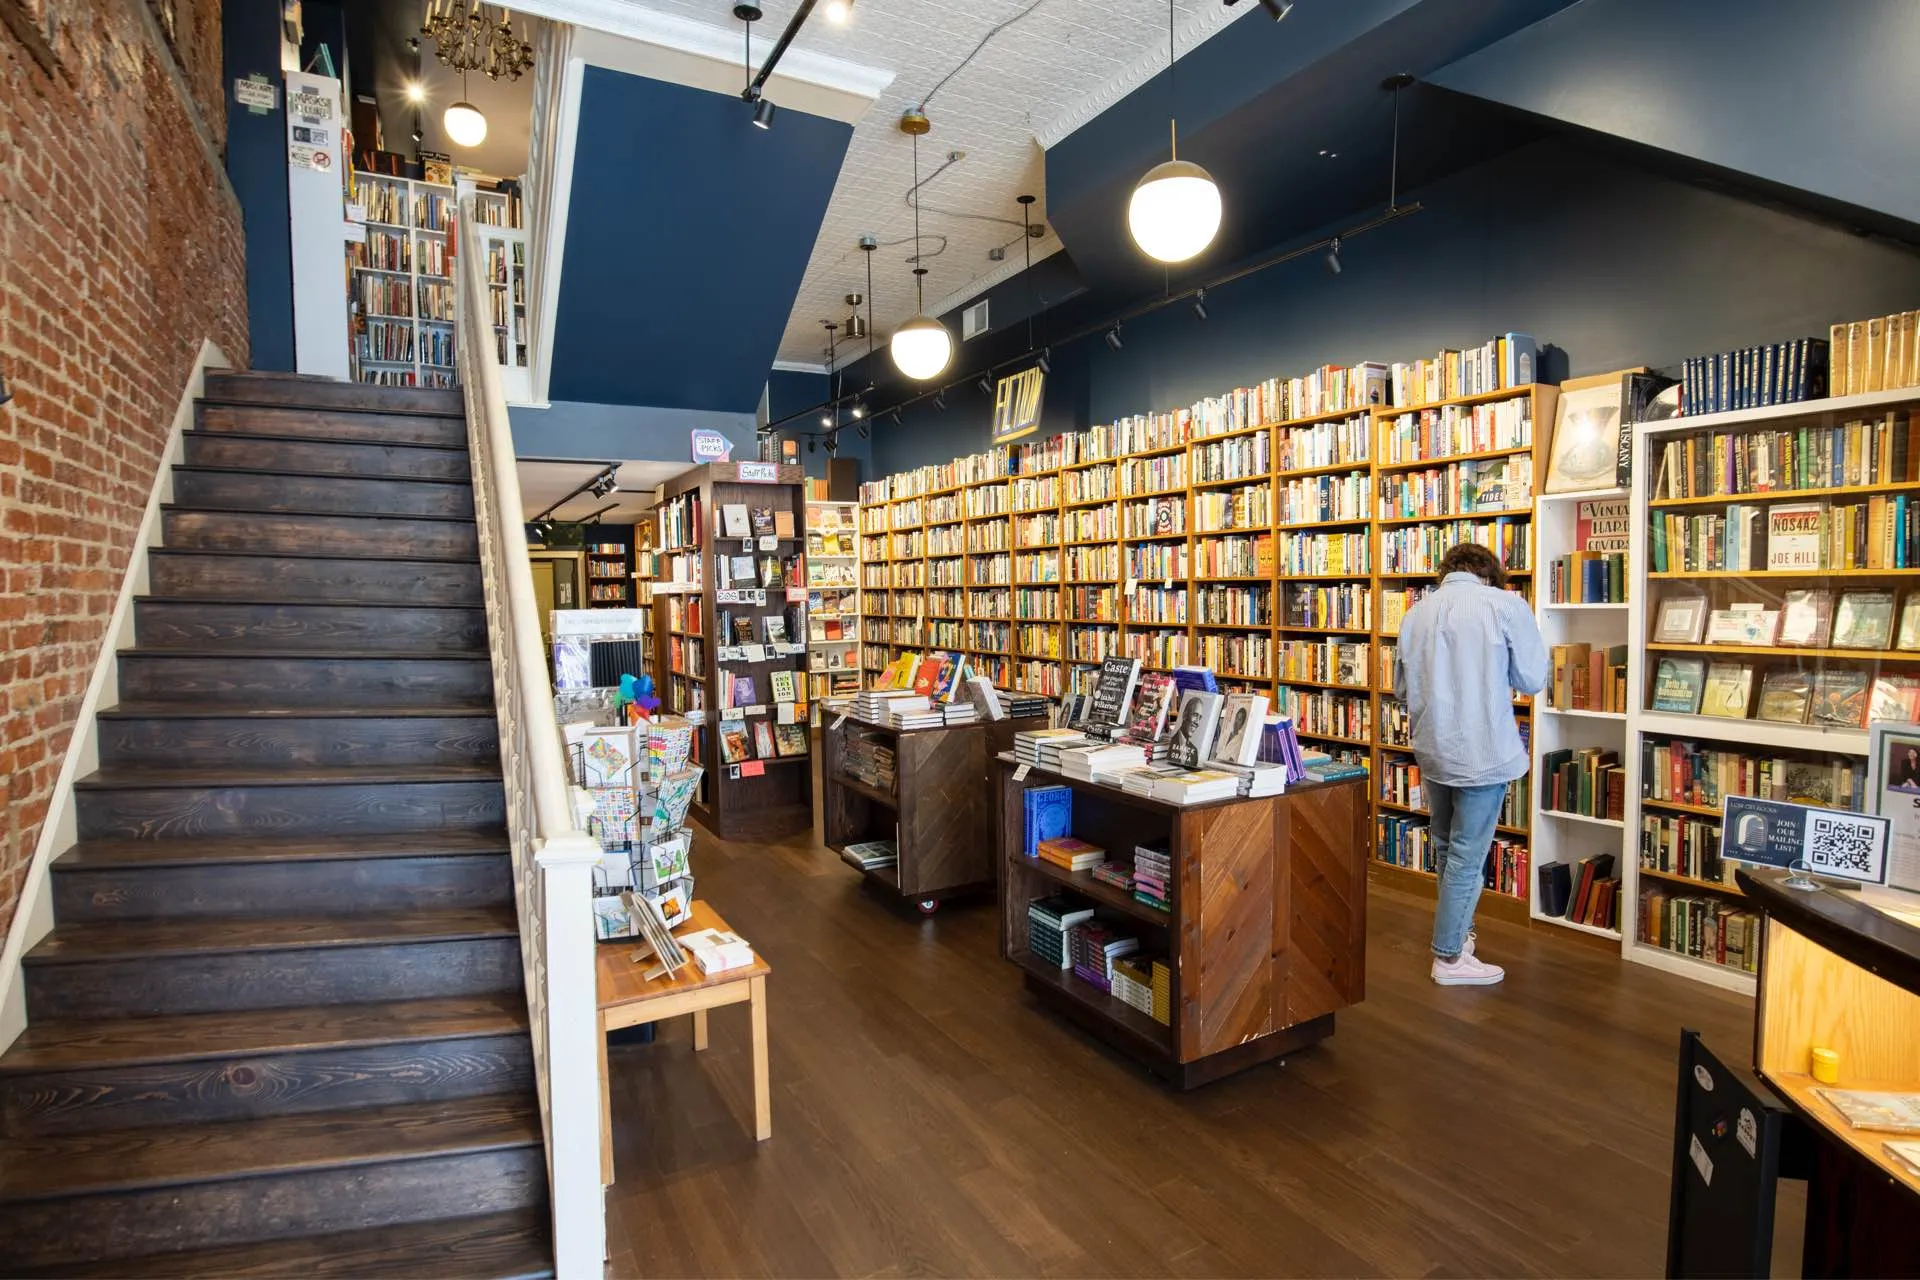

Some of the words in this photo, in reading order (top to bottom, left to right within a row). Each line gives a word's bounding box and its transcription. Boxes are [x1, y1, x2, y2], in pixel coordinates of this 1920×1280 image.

[993, 366, 1043, 435] FICTION
[1618, 421, 1631, 467] TUSCANY
[1773, 517, 1818, 532] NOS4A2
[1771, 552, 1790, 564] JOE
[1795, 551, 1817, 564] HILL
[1104, 661, 1129, 674] Caste
[1777, 820, 1796, 828] JOIN
[1777, 828, 1795, 836] OUR
[1768, 835, 1803, 845] MAILING
